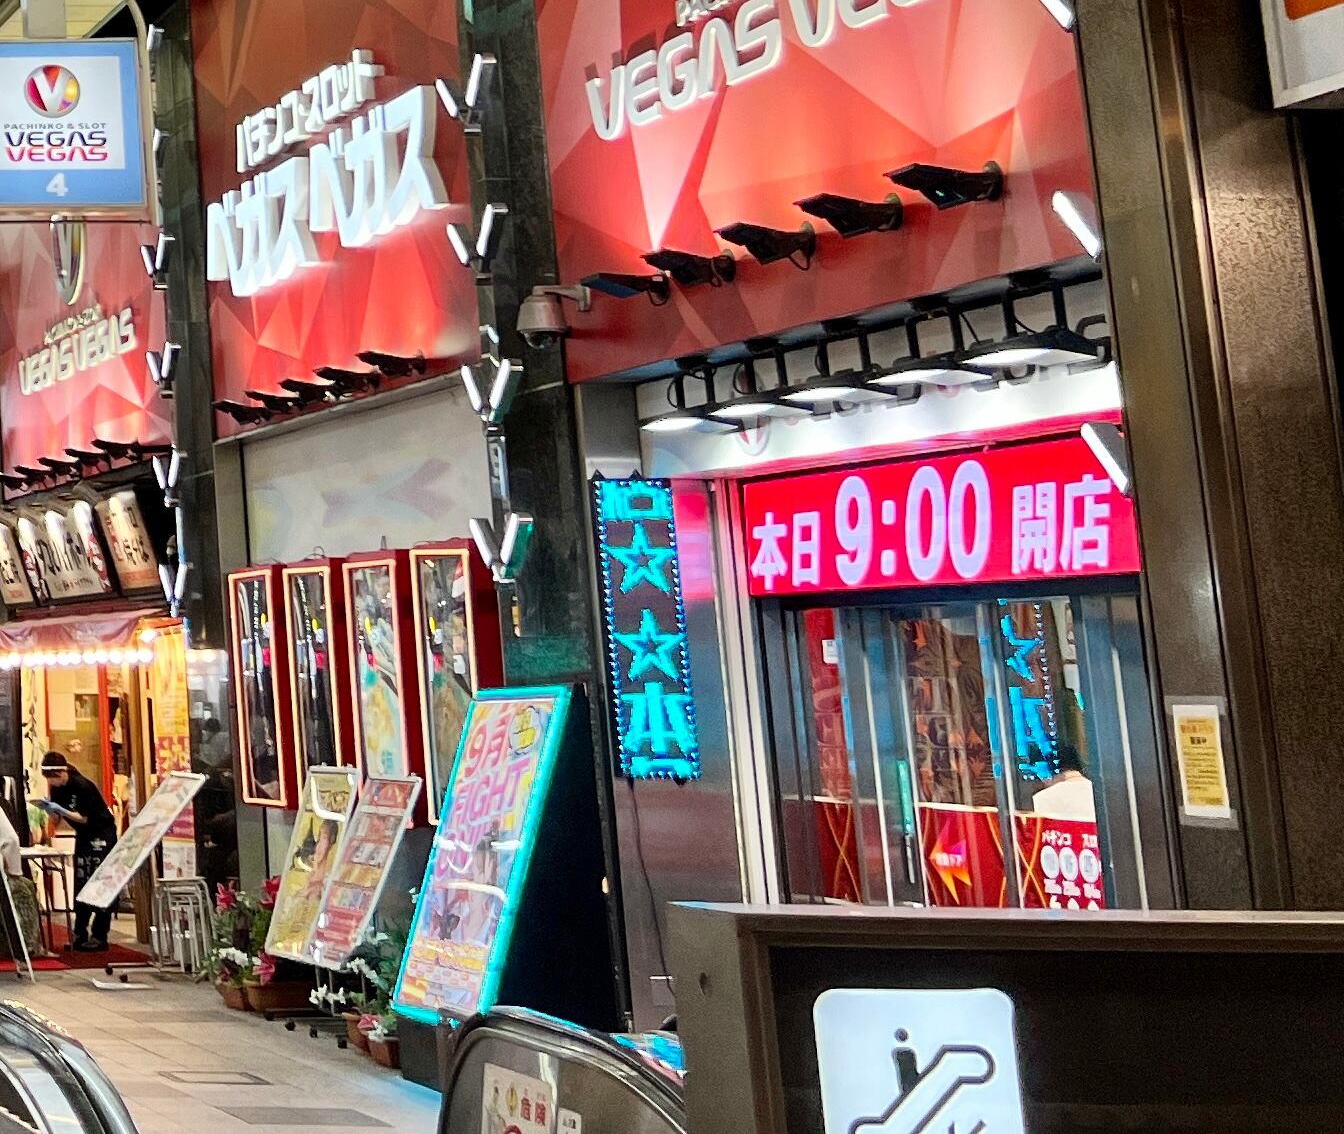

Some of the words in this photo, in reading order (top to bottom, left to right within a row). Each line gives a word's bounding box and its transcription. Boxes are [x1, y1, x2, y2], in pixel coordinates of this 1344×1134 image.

[4, 131, 108, 147] VEGAS
[5, 145, 109, 162] VEGAS
[45, 172, 69, 197] 4
[206, 154, 314, 298] ベガス
[310, 82, 440, 248] ベガス
[751, 509, 821, 592] 本日
[834, 459, 992, 586] 9:00
[1010, 473, 1112, 576] 開店
